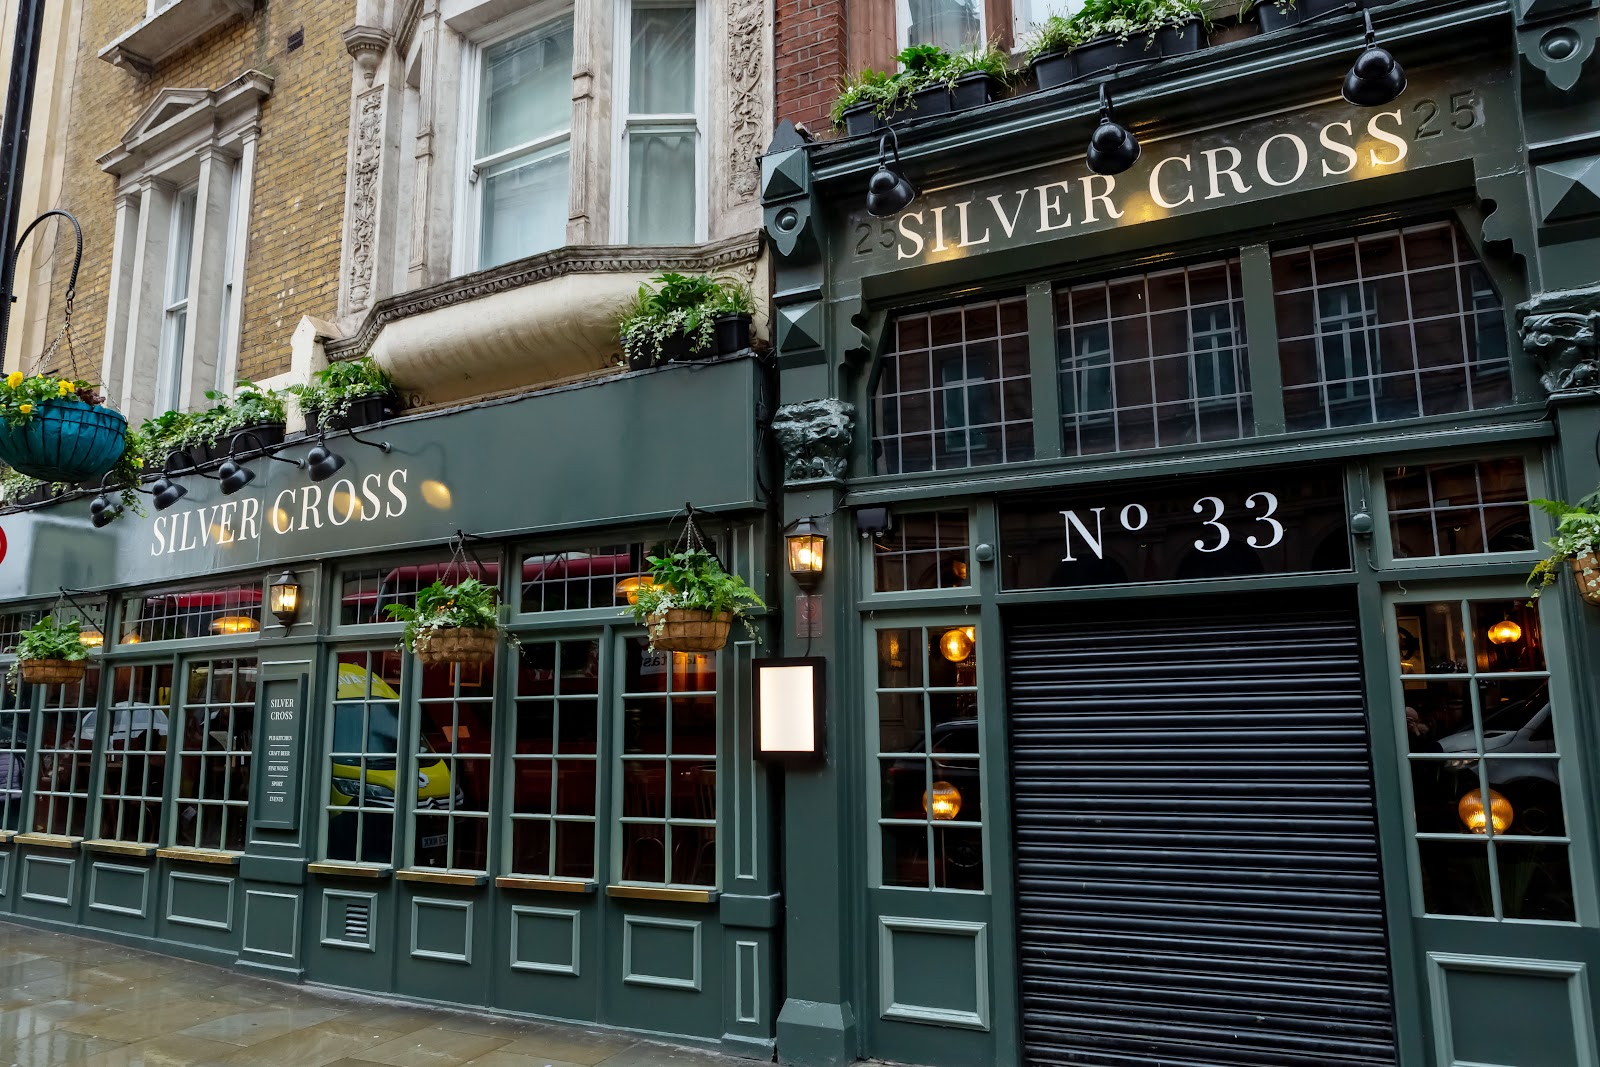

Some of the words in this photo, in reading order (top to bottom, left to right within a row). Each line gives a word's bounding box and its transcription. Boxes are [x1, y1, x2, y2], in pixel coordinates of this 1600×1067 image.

[1412, 88, 1477, 141] 25
[897, 173, 1125, 260] SILVER
[1148, 108, 1409, 209] CROSS
[854, 216, 897, 256] 25
[150, 496, 260, 557] SILVER
[271, 468, 408, 536] CROSS
[1192, 491, 1285, 553] 33
[270, 698, 294, 708] SILVER
[270, 711, 293, 721] CROSS
